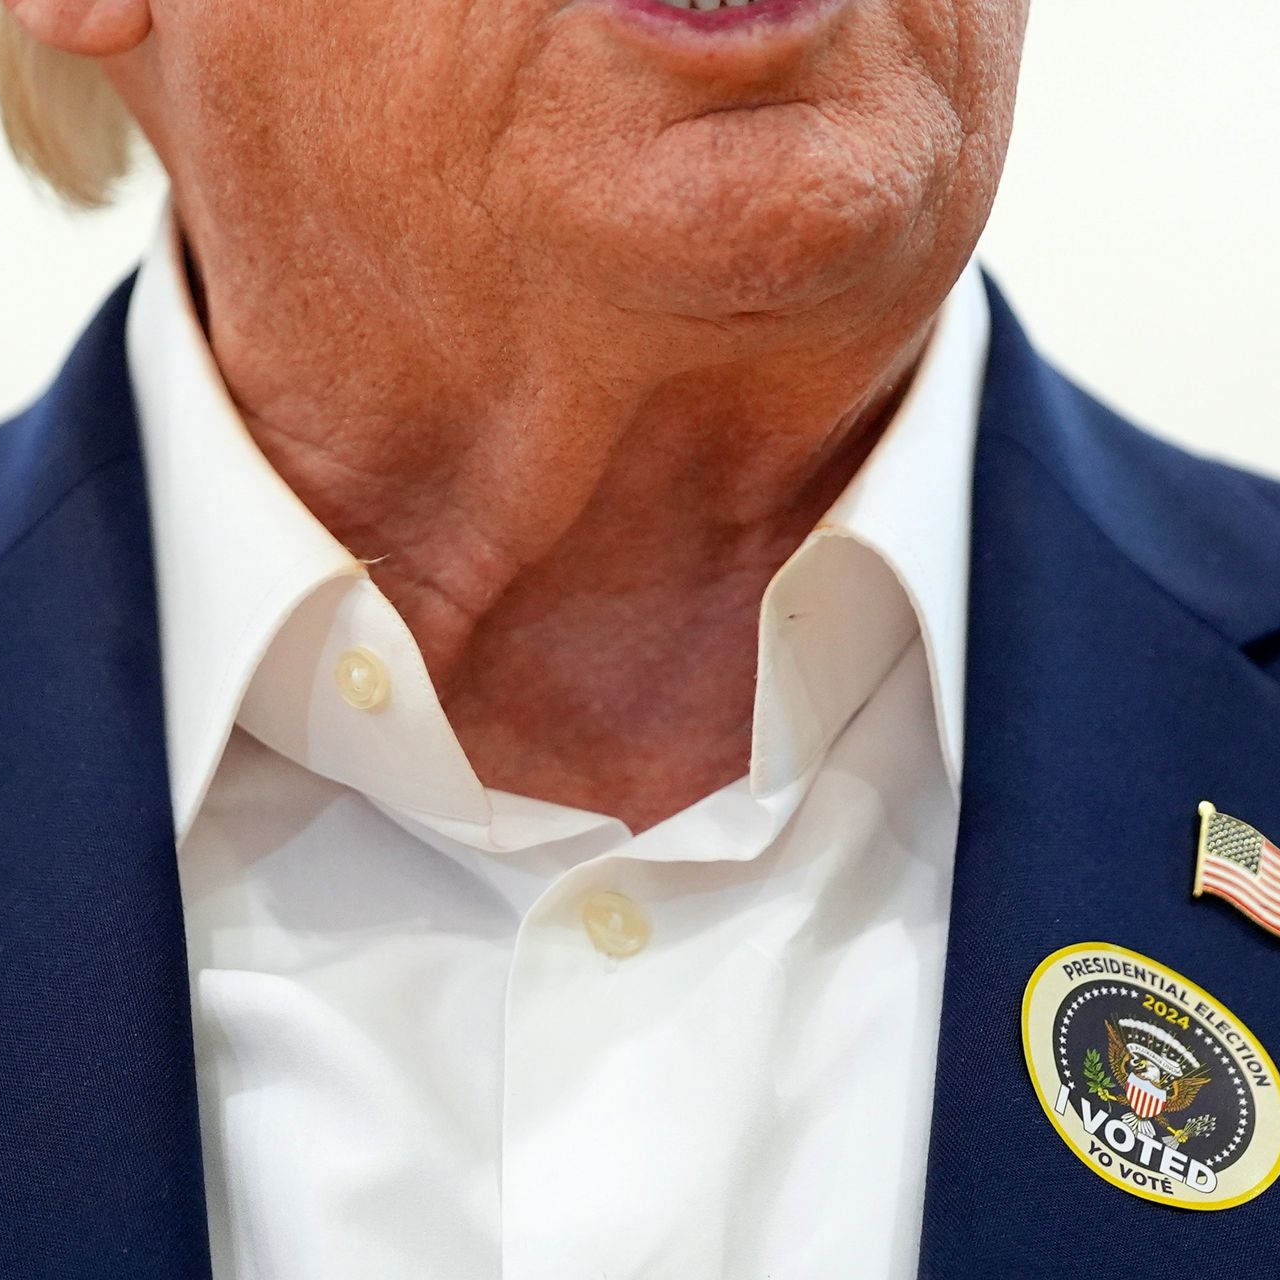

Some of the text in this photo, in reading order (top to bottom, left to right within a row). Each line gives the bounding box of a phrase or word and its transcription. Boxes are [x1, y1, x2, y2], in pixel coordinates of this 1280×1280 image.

[1062, 957, 1190, 1006] PRESIDENTIAL
[1194, 1001, 1272, 1088] ELECTION
[1141, 993, 1191, 1031] 2024
[1054, 1083, 1218, 1194] I VOTED
[1087, 1140, 1174, 1195] YO VOTÉ
